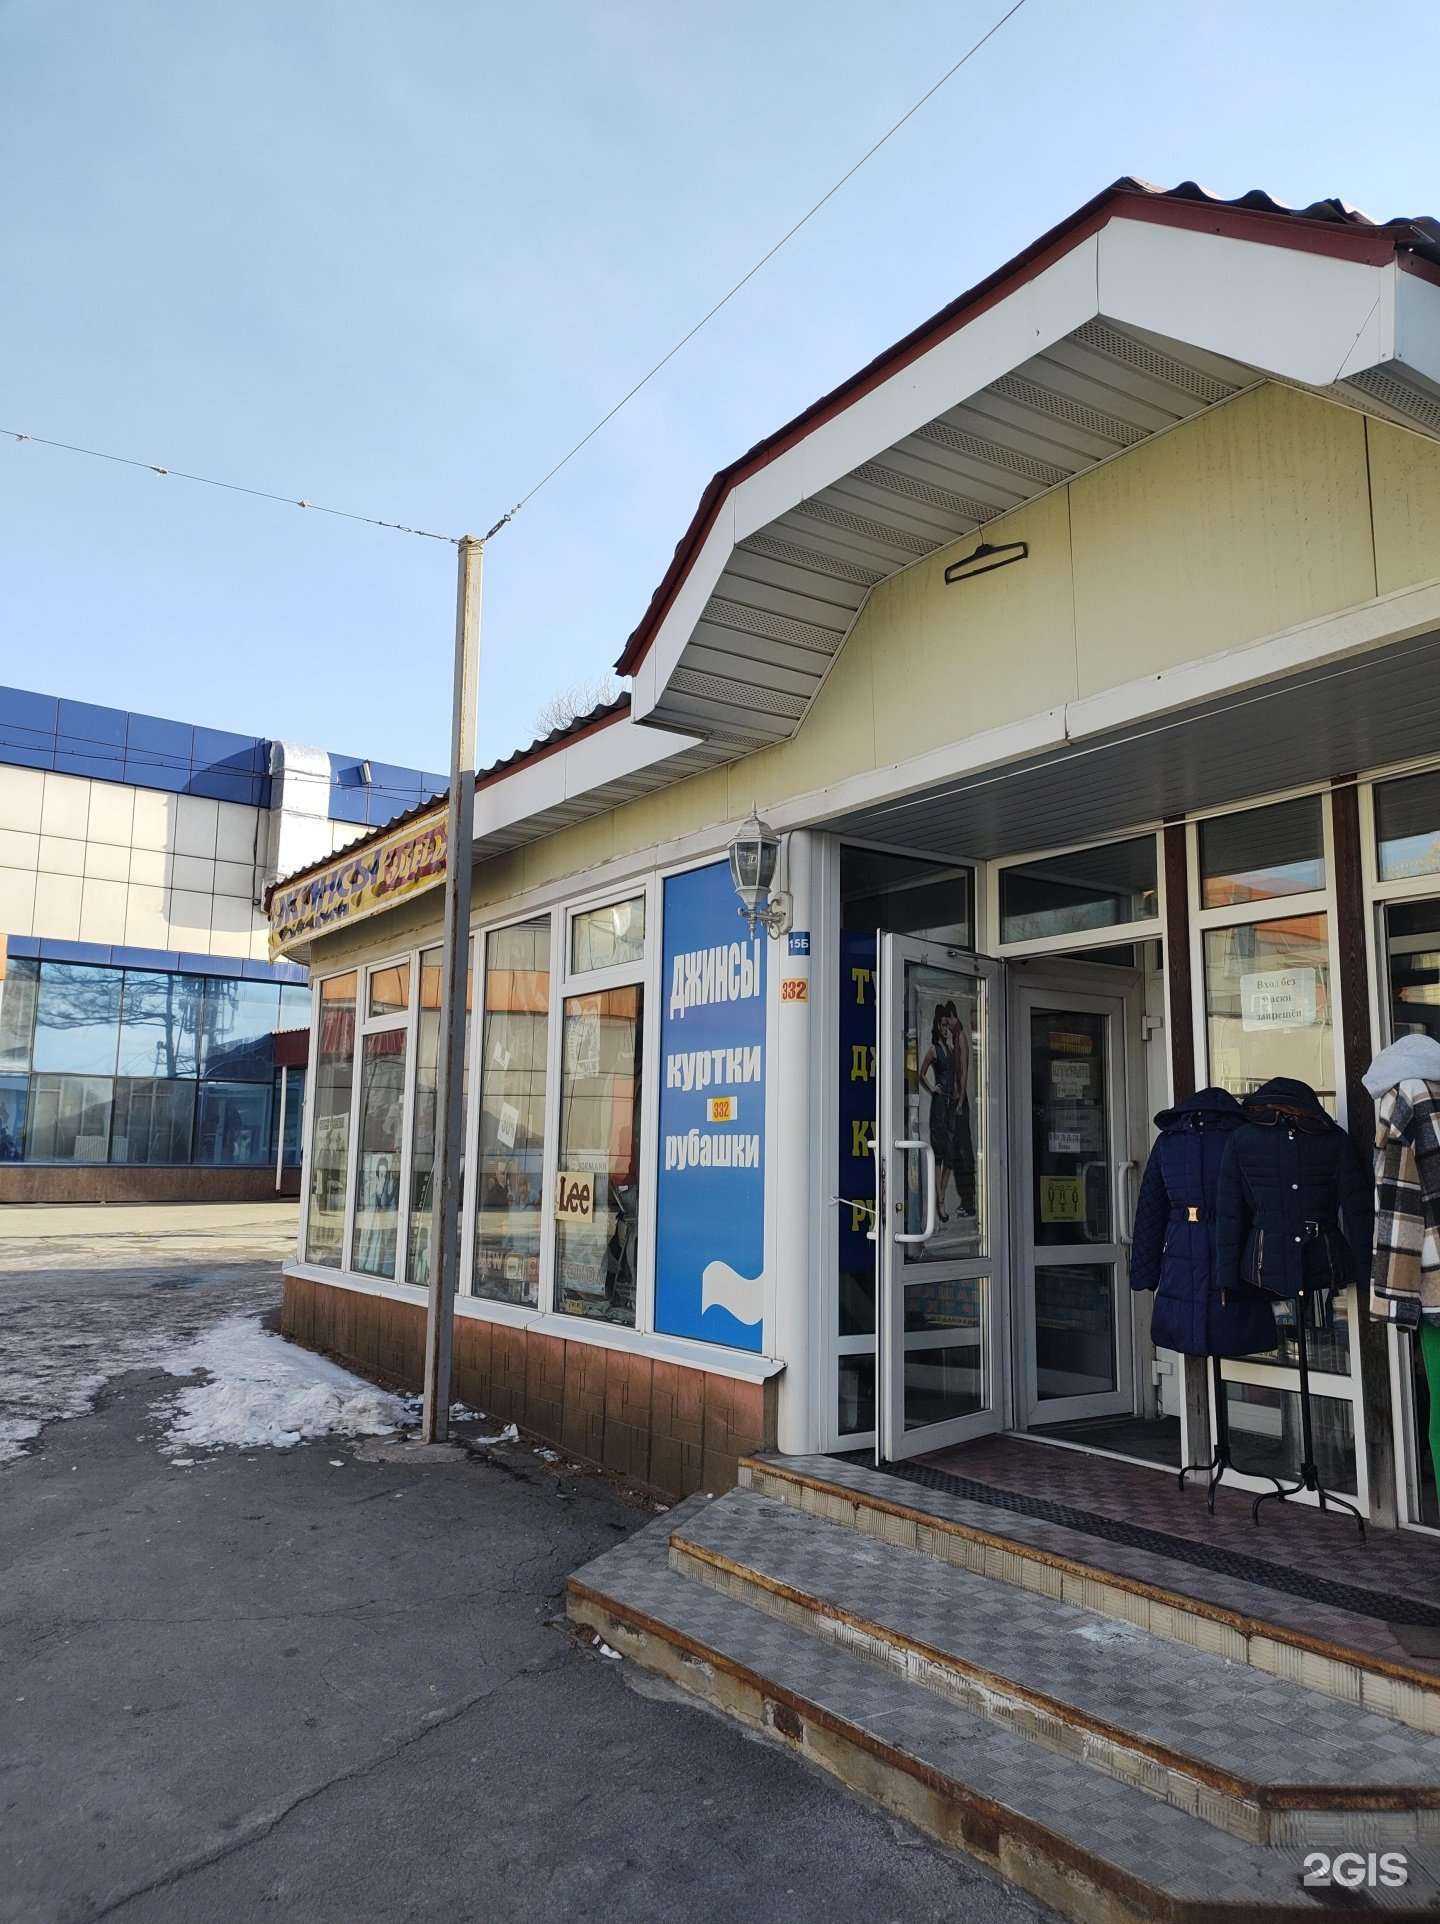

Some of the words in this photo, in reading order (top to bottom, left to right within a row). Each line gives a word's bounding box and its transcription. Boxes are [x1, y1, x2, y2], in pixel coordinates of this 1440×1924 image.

[782, 981, 806, 1000] 332
[713, 1101, 729, 1118] 332
[665, 1129, 760, 1170] рубашки
[558, 1175, 590, 1215] Lee
